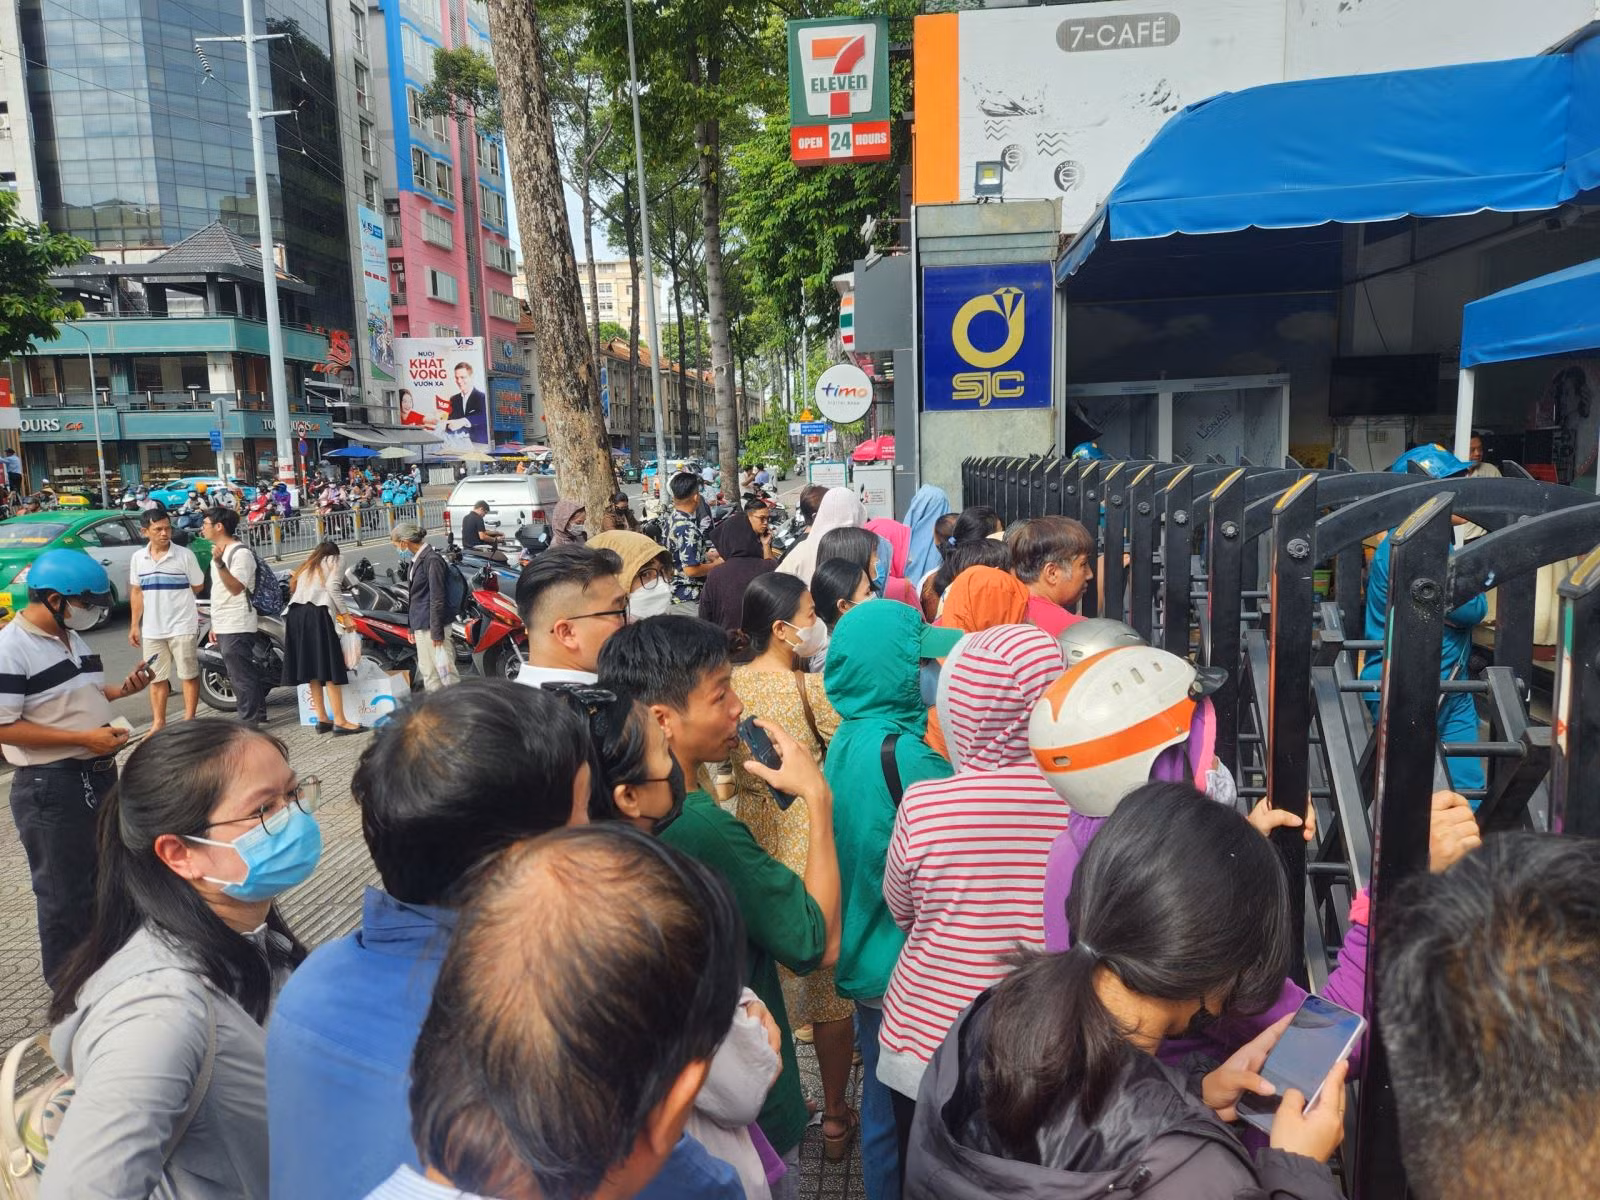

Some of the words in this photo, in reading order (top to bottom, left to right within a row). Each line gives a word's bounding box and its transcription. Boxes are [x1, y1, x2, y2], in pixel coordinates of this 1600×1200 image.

[1070, 17, 1166, 48] 7-CAFÉ
[798, 137, 823, 149] OPEN
[830, 132, 851, 151] 24
[855, 133, 887, 145] HOURS
[409, 356, 444, 369] KHÁT
[409, 369, 447, 380] VỌNG
[821, 382, 868, 398] timo
[952, 371, 1025, 407] SJC
[20, 418, 61, 432] OURS
